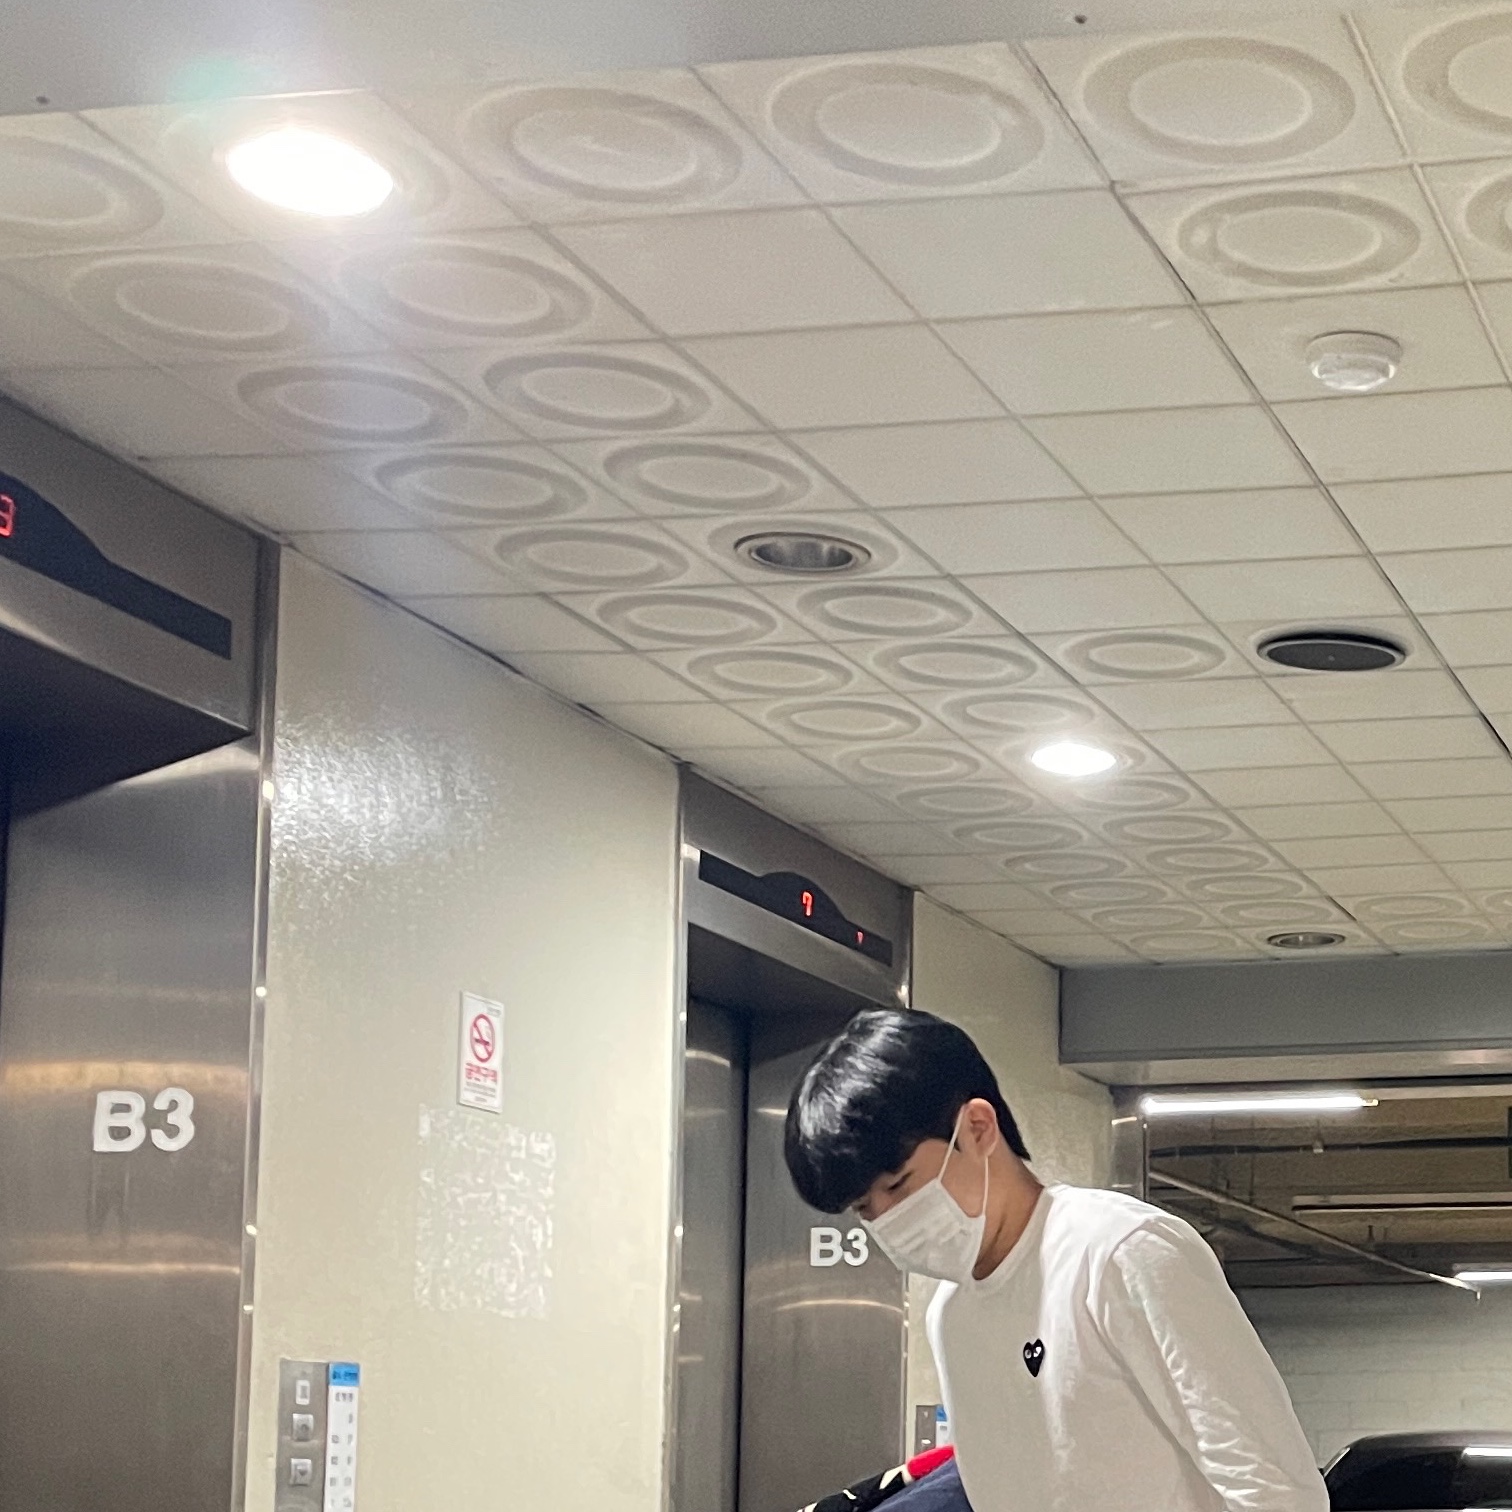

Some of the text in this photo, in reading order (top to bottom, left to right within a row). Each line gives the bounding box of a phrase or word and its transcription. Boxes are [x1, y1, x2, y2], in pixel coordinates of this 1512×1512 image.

[802, 891, 813, 917] 7
[93, 1087, 195, 1152] B3
[810, 1227, 869, 1267] B3
